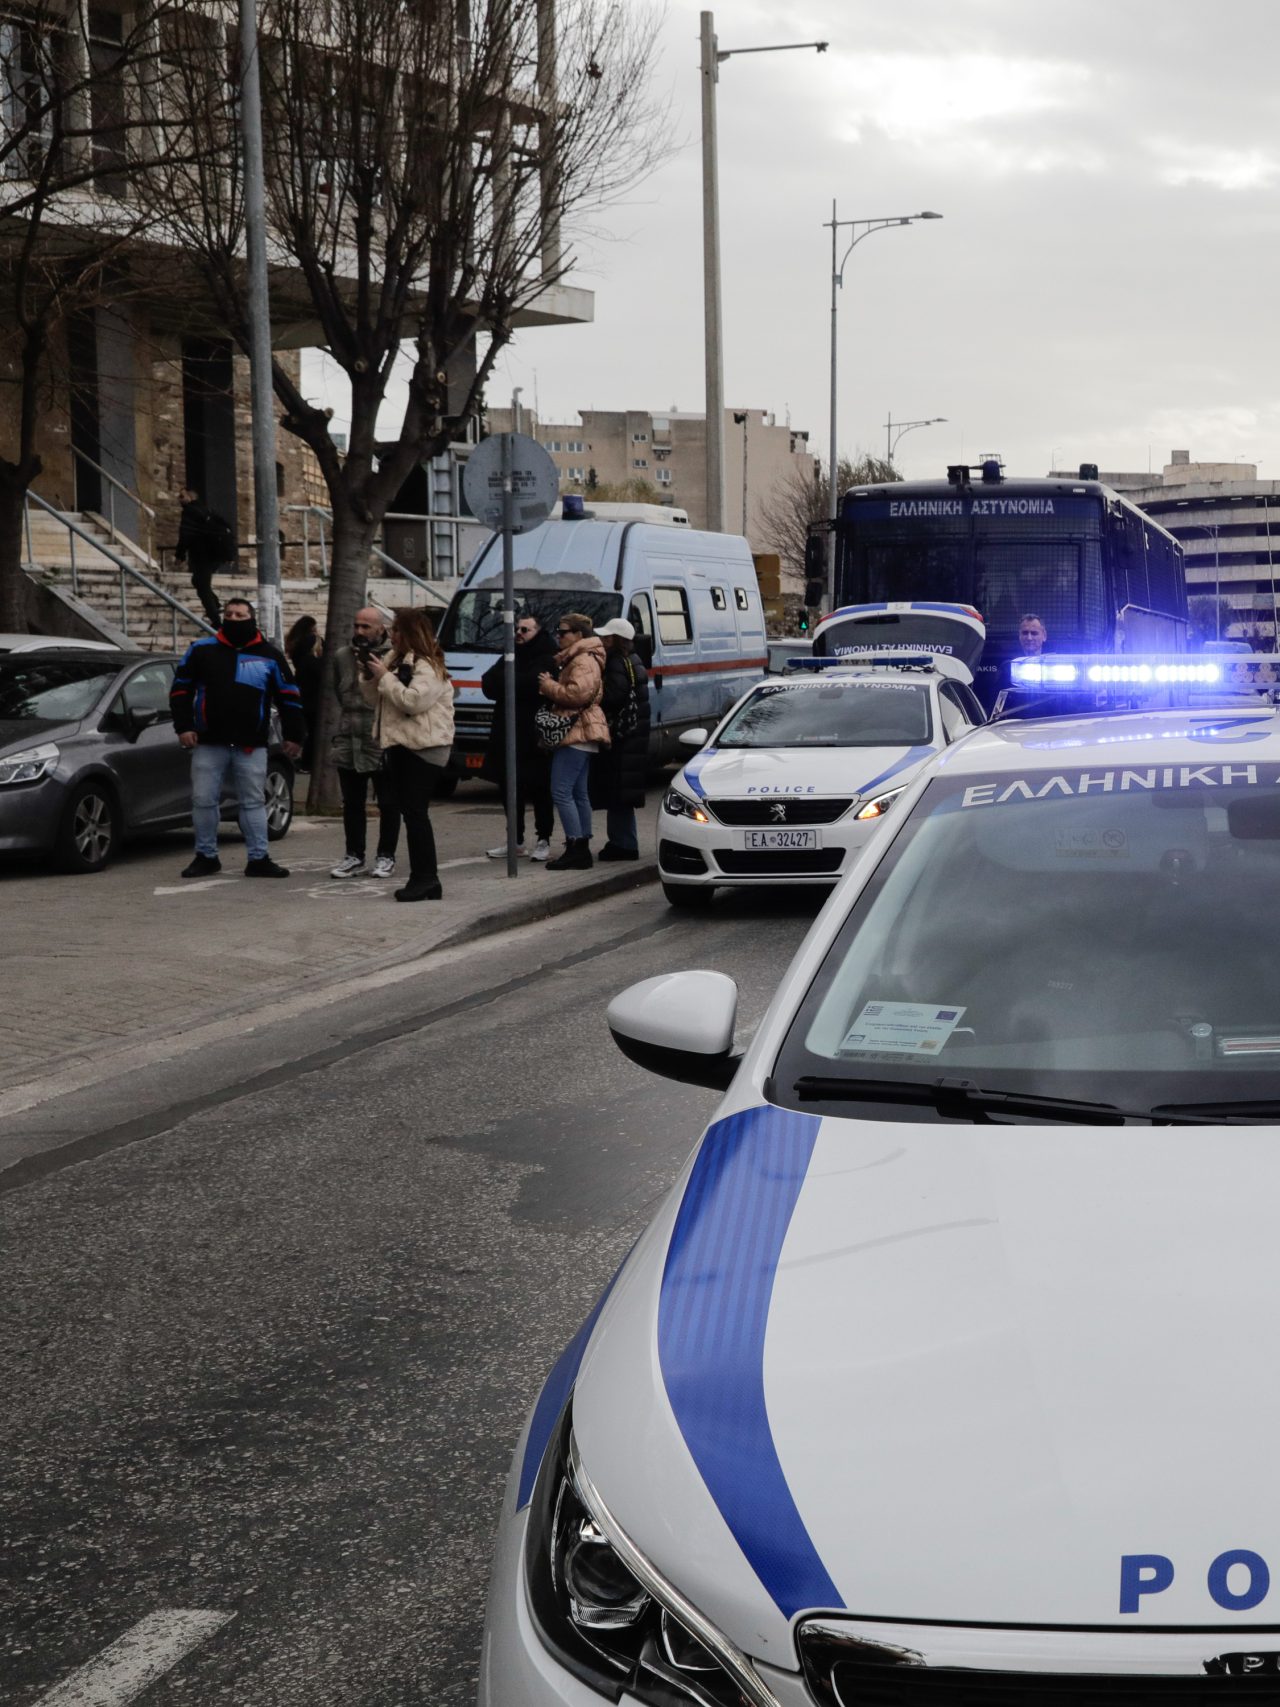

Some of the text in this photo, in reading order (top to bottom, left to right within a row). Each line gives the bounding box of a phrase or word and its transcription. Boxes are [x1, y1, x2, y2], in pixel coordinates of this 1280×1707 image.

[890, 499, 1055, 517] ΕΛΛΗΝΙΚΗ ΑΣΤΥΝΟΜΙΑ
[834, 643, 953, 656] ΕΛΛΗΝΙΚΗ ΑΣΤΥΝΟΜΙΑ
[762, 682, 917, 694] ΕΛΛΗΝΙΚΗ ΑΣΤΥΝΟΜΙΑ
[747, 786, 815, 794] POLICE
[961, 764, 1258, 808] ΕΛΛΗΝΙΚΗ
[776, 832, 809, 847] 32427
